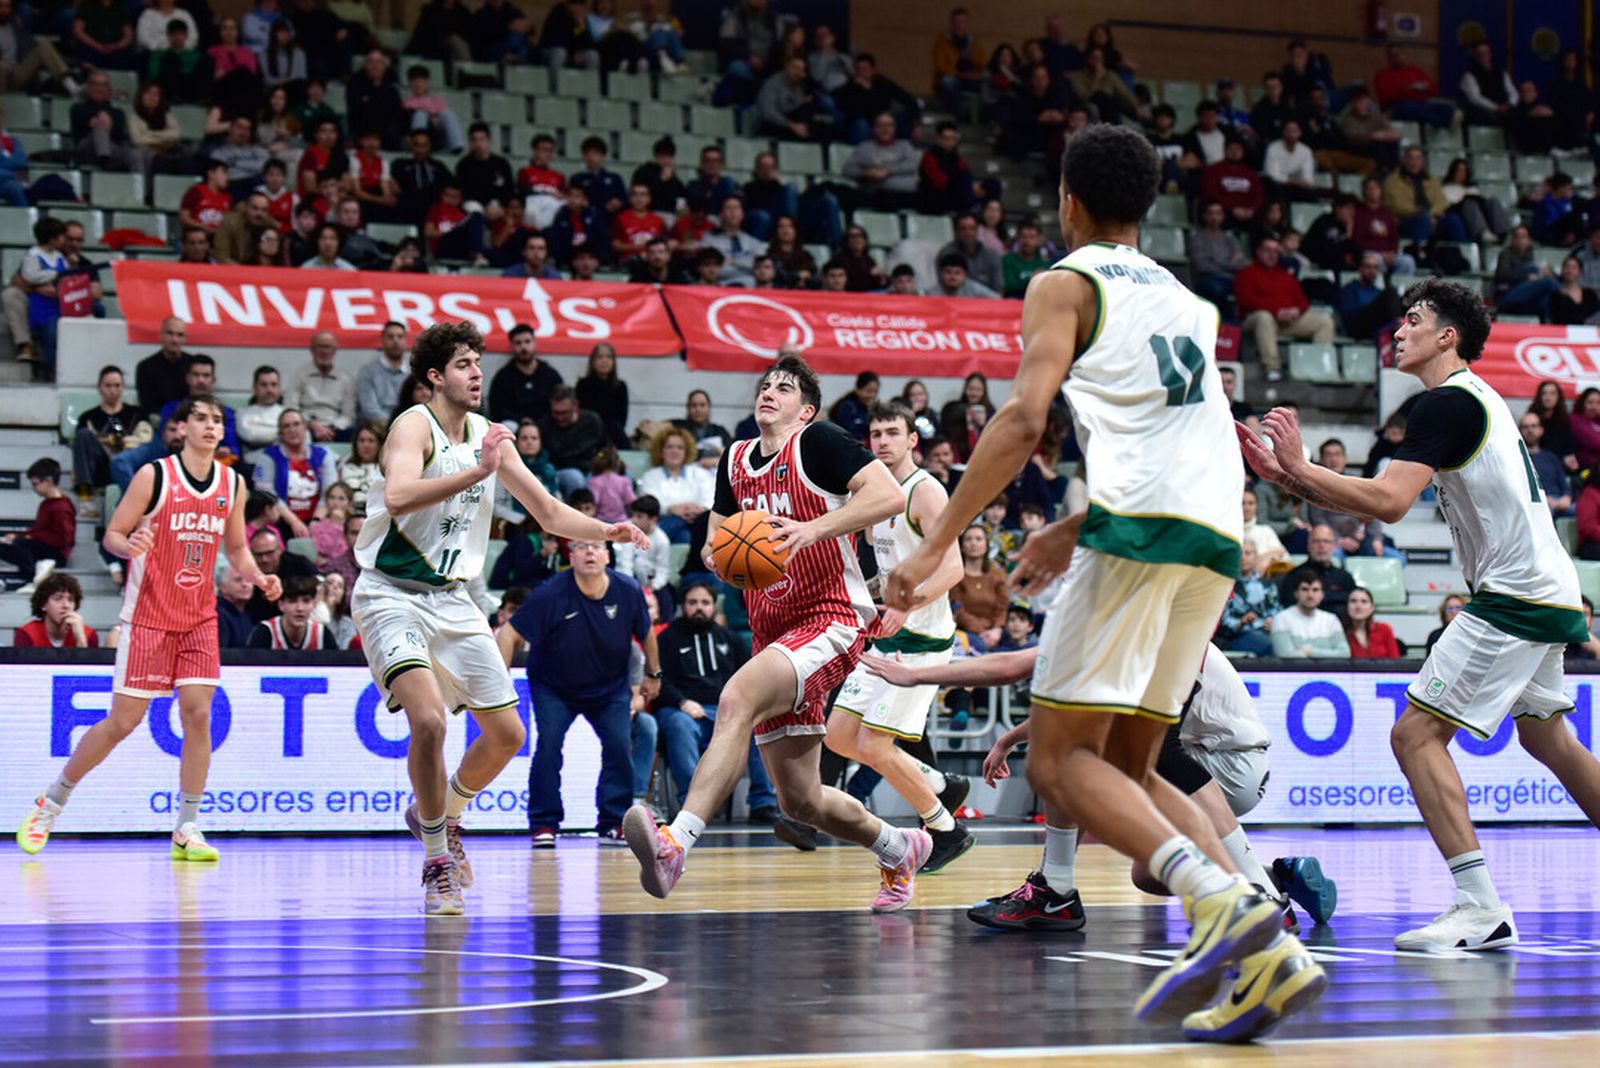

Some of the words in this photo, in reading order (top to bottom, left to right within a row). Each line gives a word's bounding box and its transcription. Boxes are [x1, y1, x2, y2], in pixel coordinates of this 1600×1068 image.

[965, 331, 1012, 352] DE
[741, 491, 793, 516] CAM
[170, 512, 225, 536] UCAM
[184, 544, 203, 568] 14
